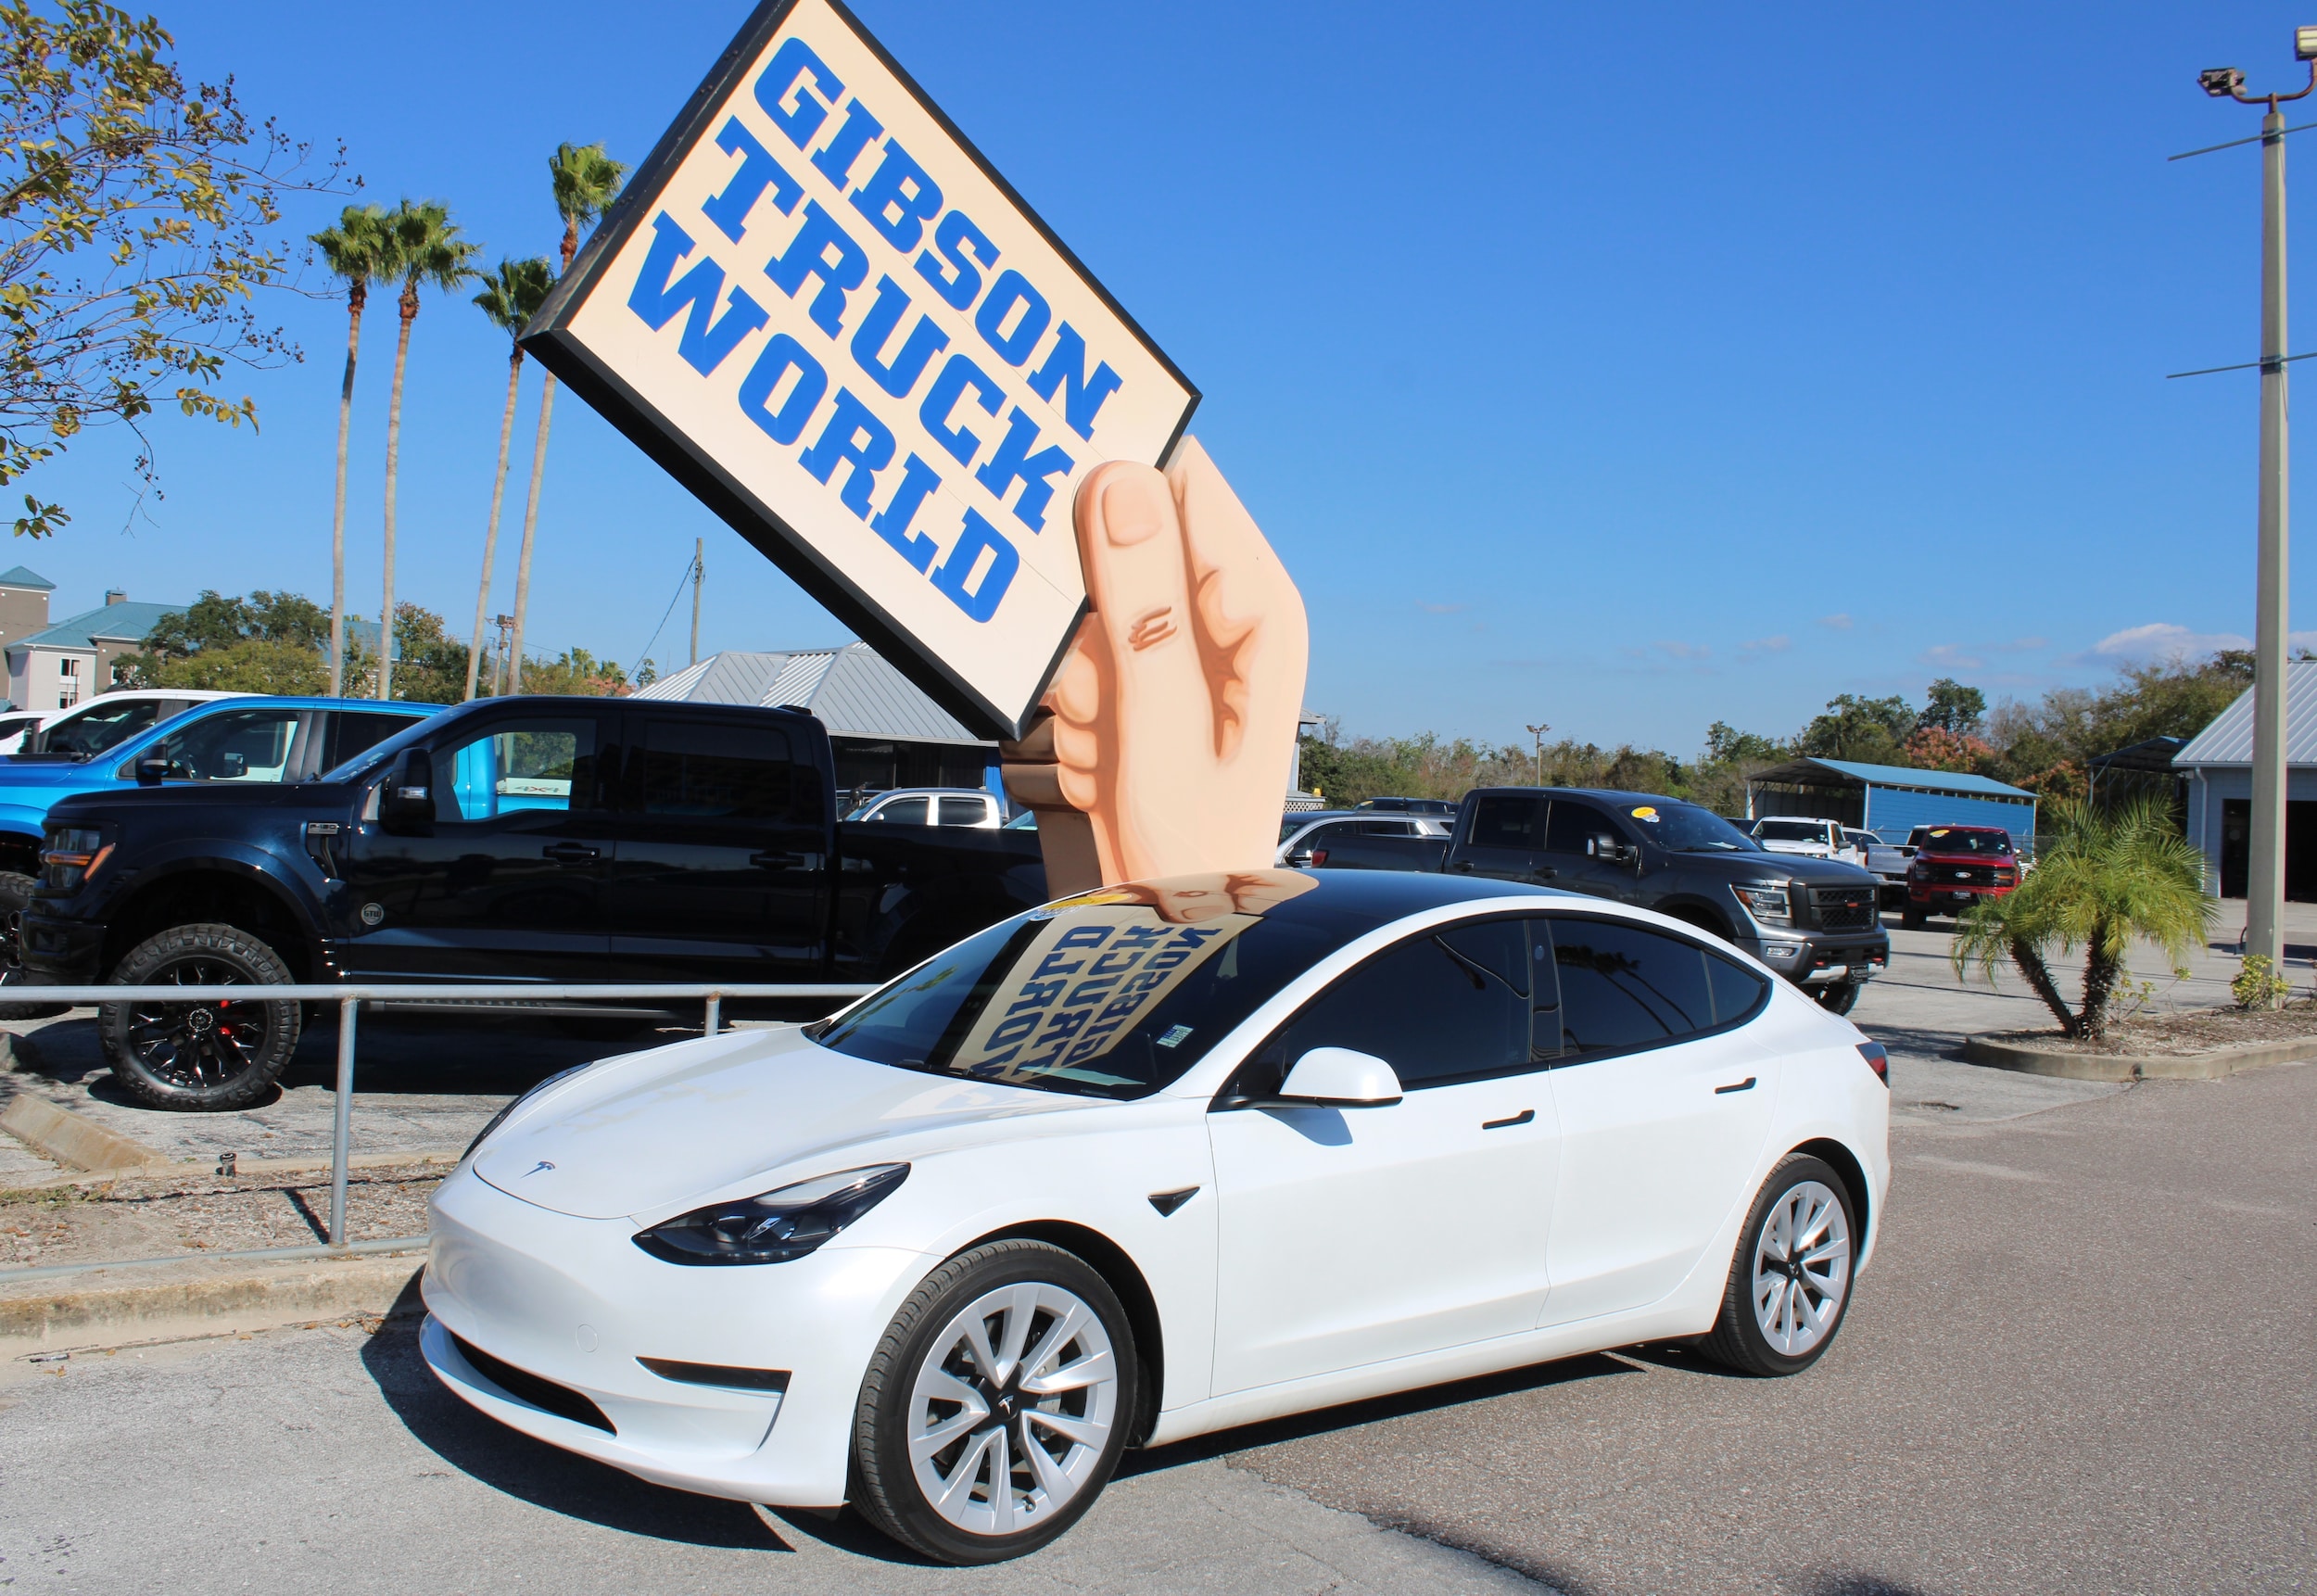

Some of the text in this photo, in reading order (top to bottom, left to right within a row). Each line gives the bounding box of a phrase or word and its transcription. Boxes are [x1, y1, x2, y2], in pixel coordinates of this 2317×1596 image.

[627, 209, 1019, 624] WORLD
[701, 115, 1075, 535] TRUCK
[753, 37, 1123, 442] GIBSON
